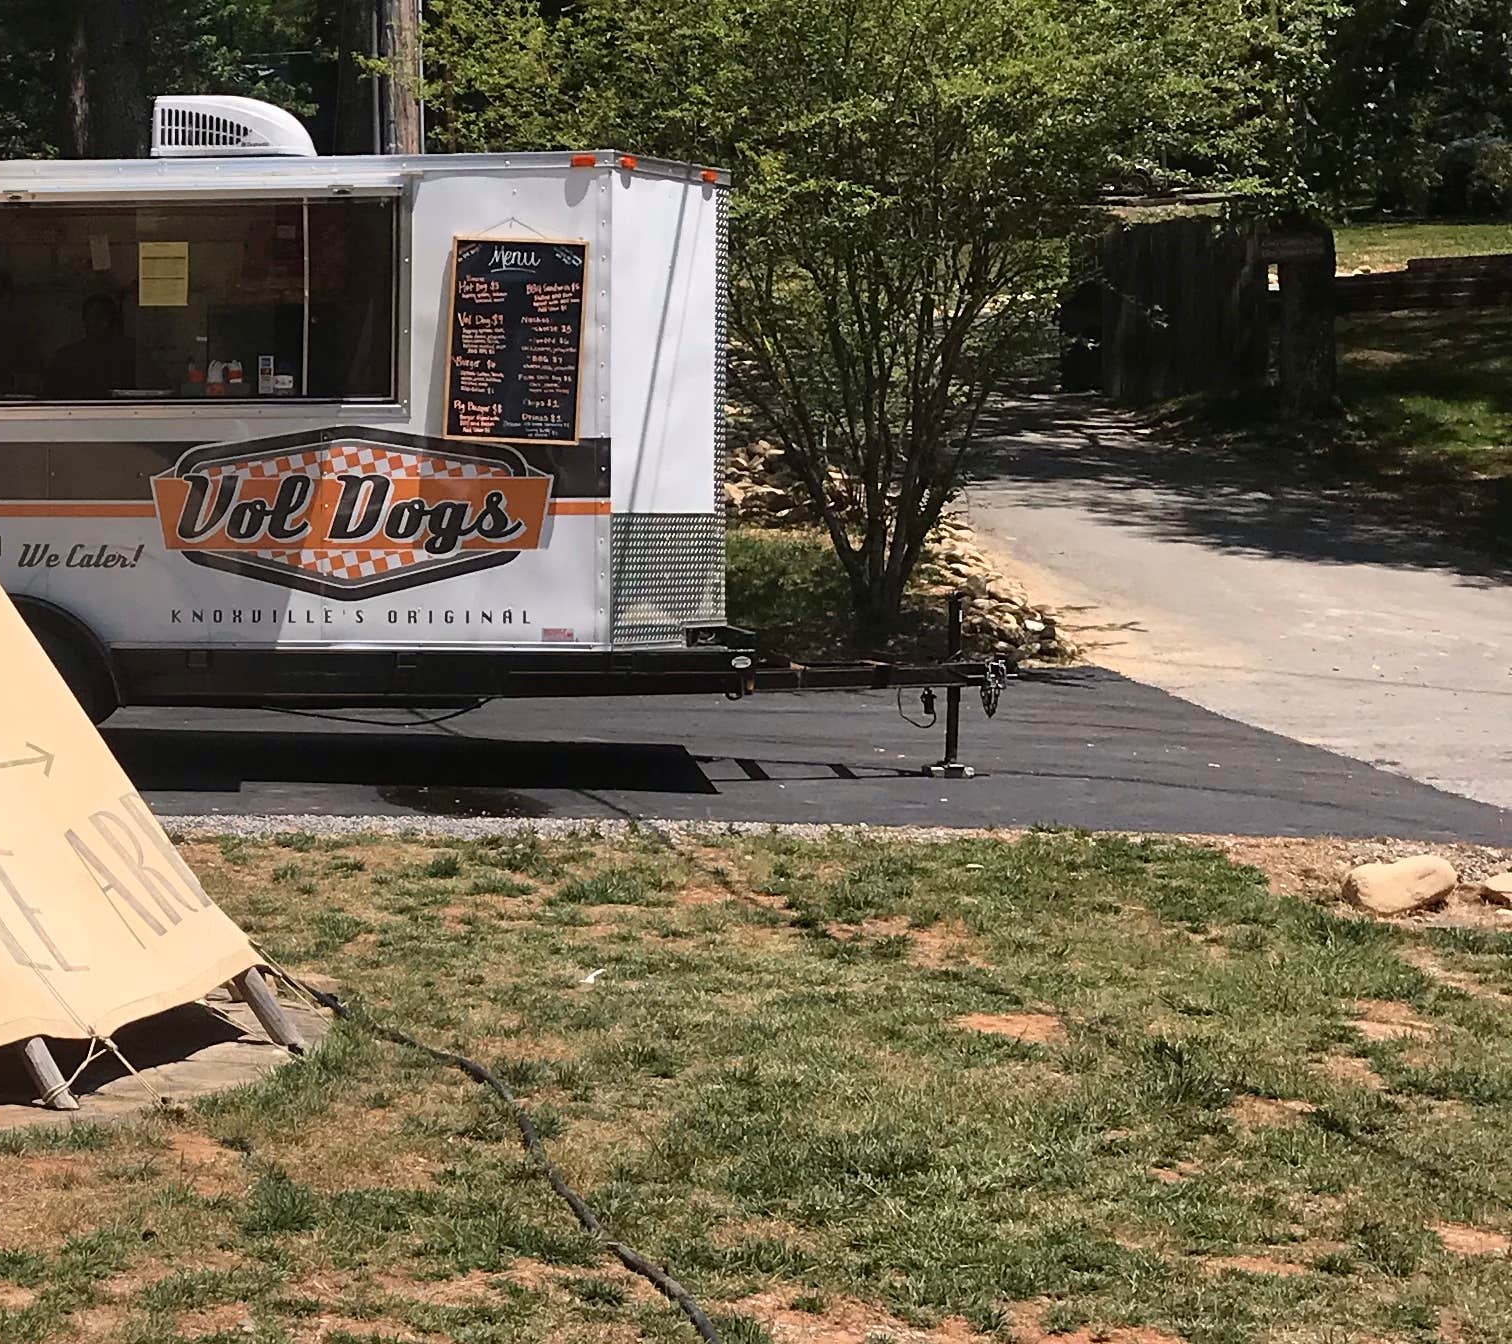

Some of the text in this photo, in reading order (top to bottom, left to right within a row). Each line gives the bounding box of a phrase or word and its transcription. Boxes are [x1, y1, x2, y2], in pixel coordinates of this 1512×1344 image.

[488, 245, 541, 270] Menu
[457, 311, 472, 326] Vol
[475, 315, 491, 328] Dog
[177, 473, 525, 555] Vol Dogs
[18, 543, 145, 569] We Cater!
[171, 608, 532, 624] KNOXVILLE'S ORIGINAL
